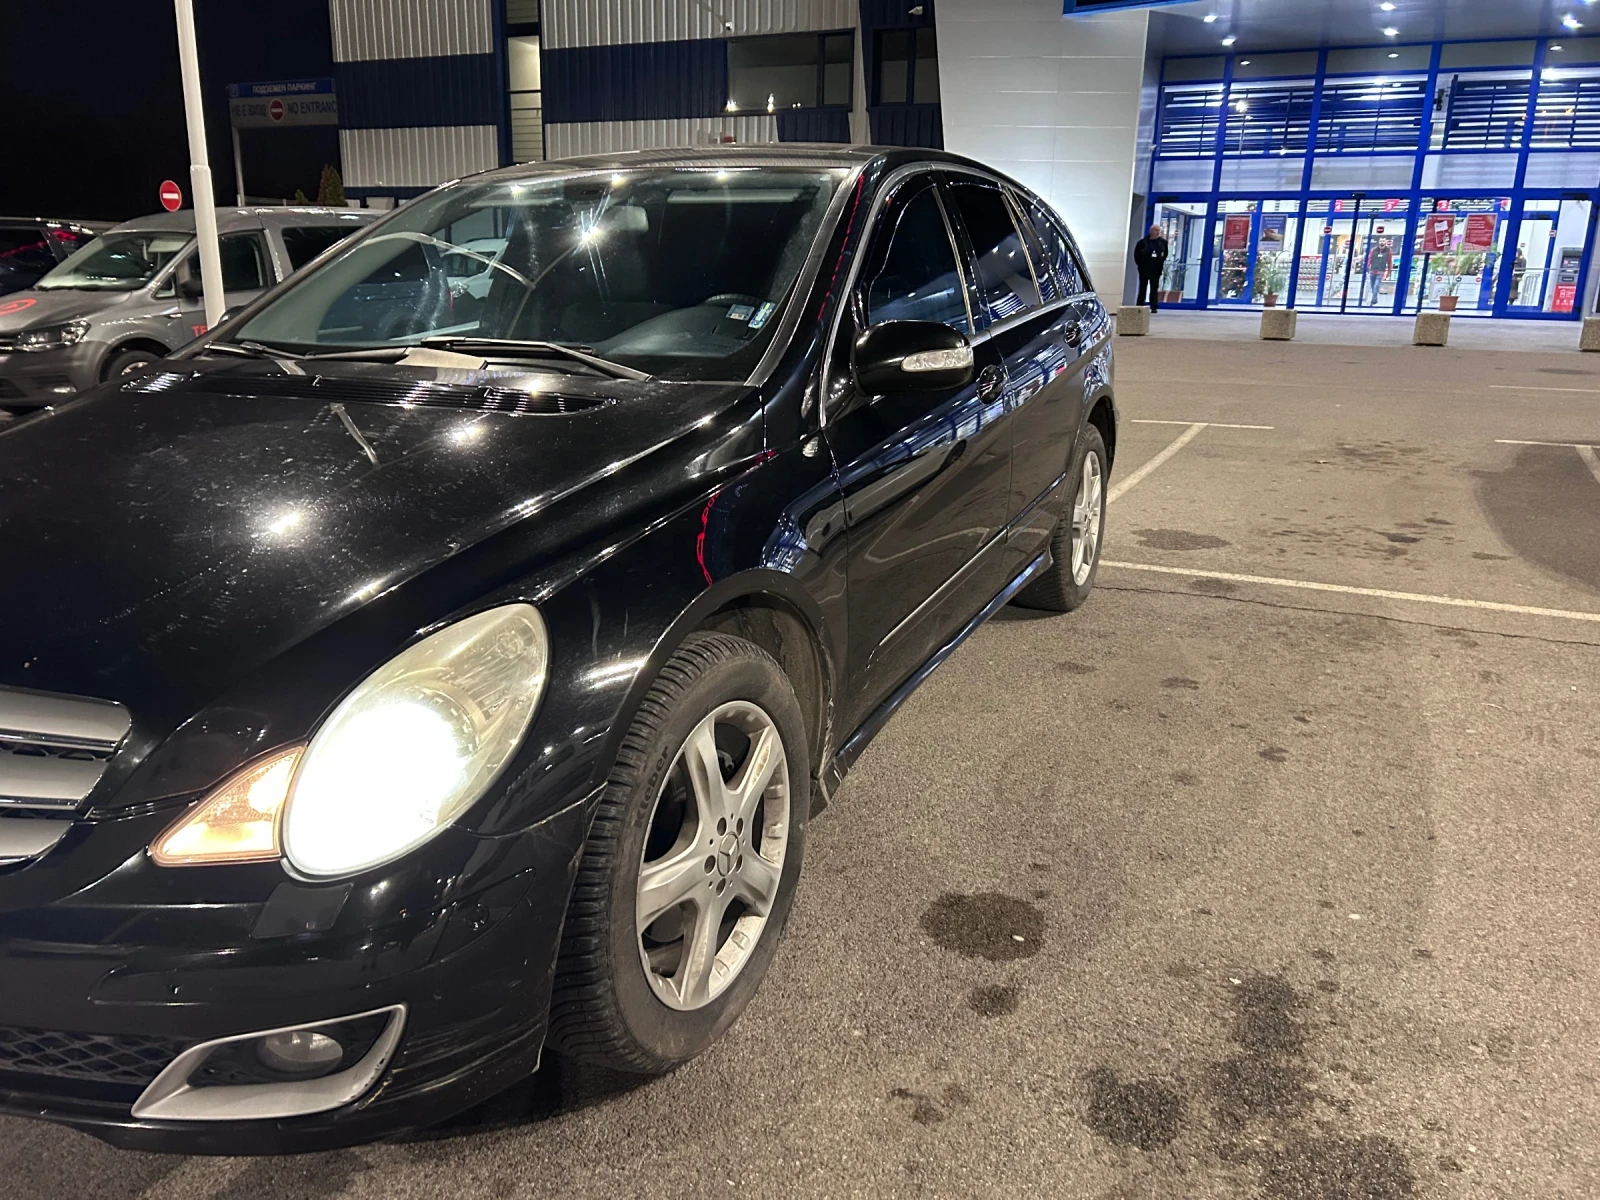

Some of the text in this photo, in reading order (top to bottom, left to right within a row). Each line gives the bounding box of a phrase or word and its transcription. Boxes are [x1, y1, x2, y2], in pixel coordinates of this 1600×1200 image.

[287, 82, 317, 91] ПАРКИНГ
[288, 100, 337, 115] NO ENTRANC
[633, 745, 669, 829] Kleber
